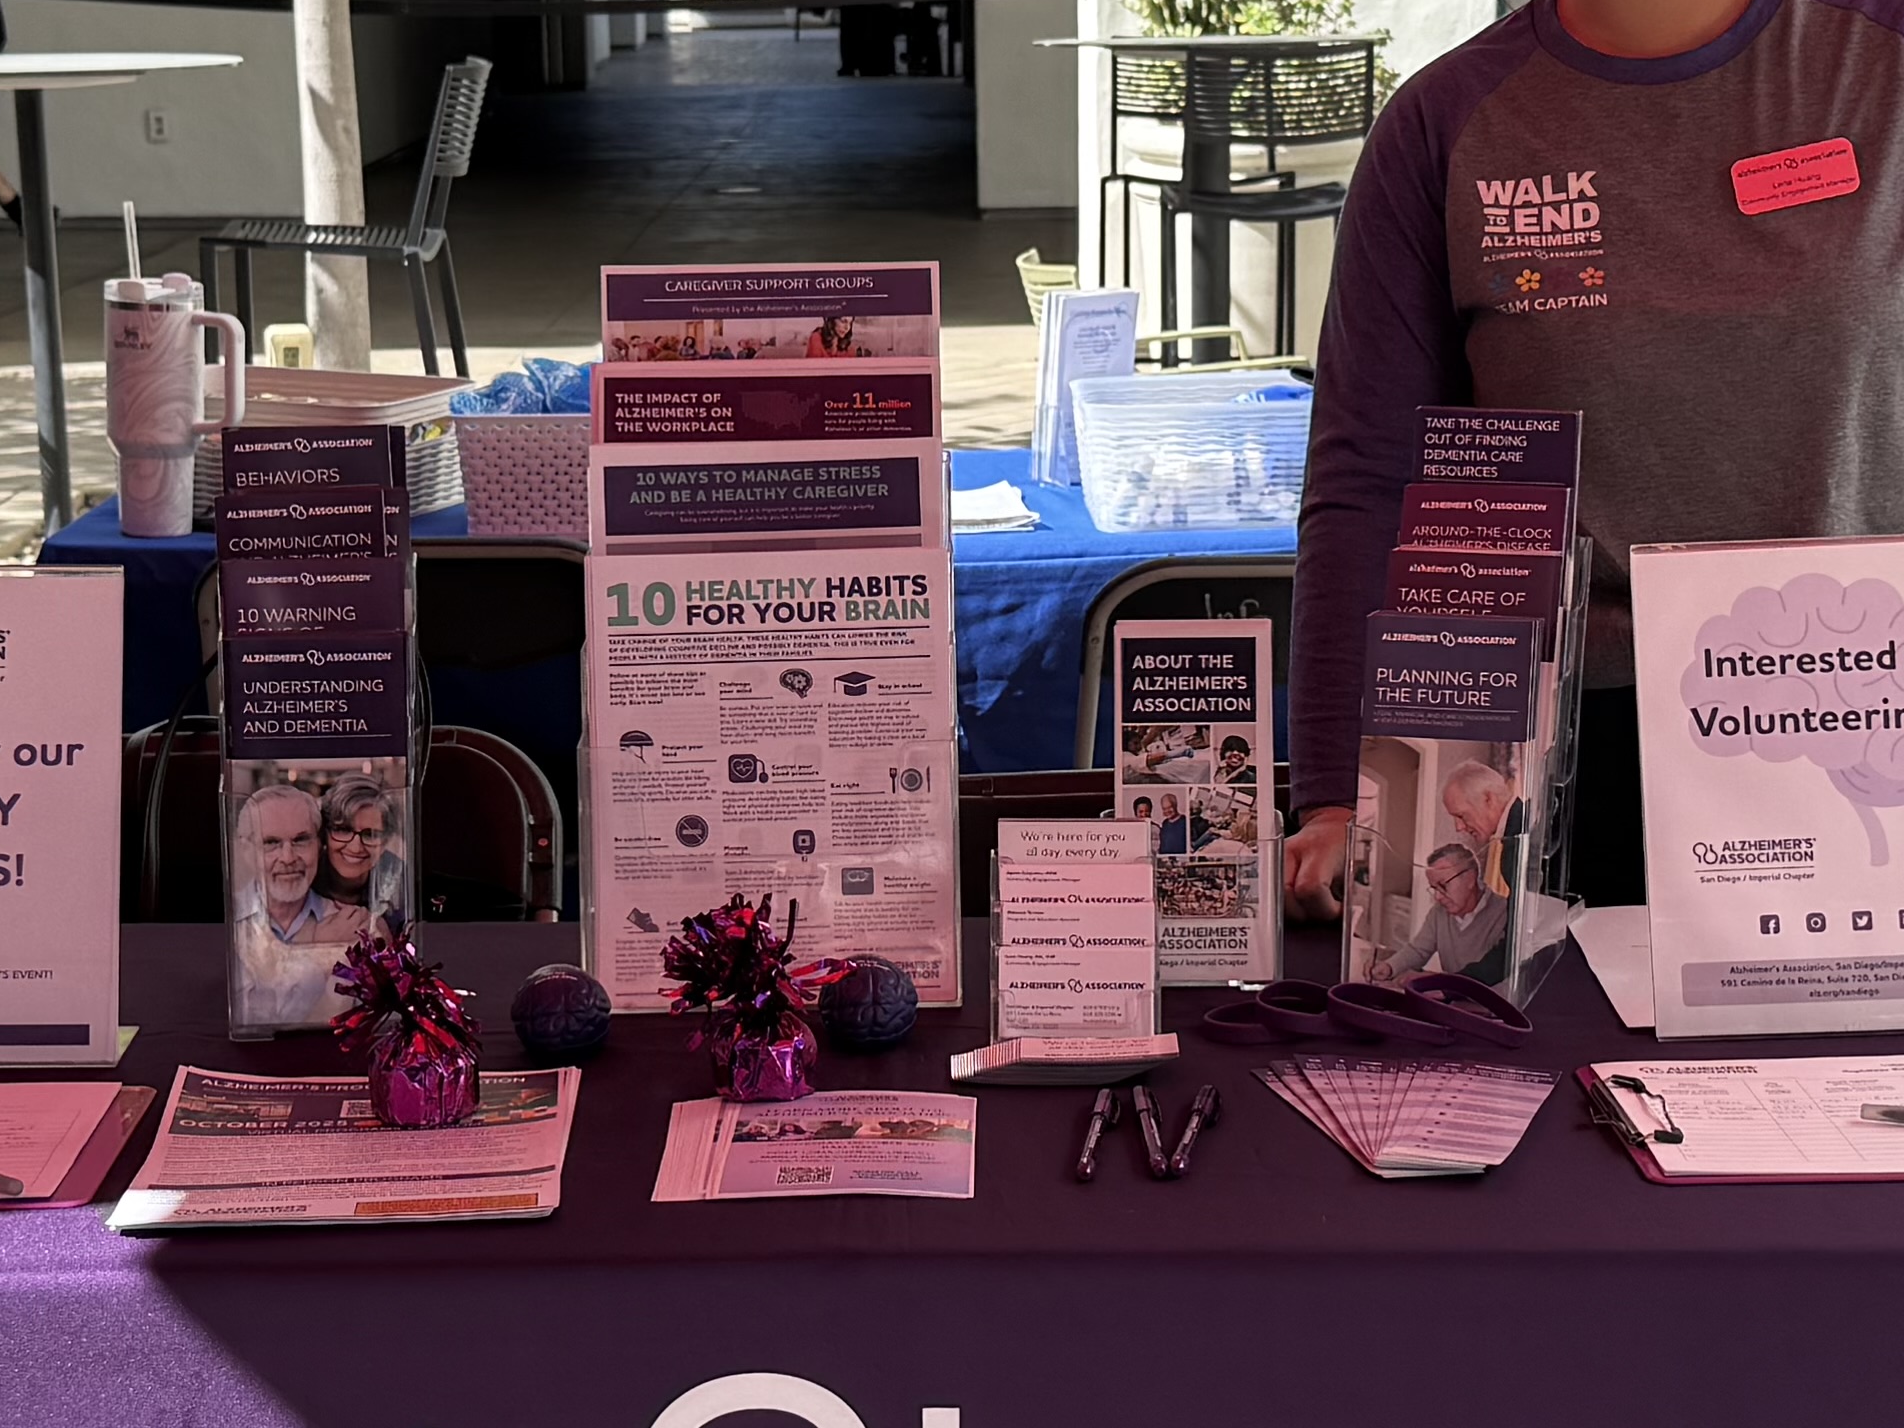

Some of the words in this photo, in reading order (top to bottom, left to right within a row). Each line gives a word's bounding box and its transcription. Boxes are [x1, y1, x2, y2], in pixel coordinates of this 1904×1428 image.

[1477, 171, 1597, 207] WALK
[1488, 215, 1506, 226] TO
[1514, 202, 1600, 233] END
[1481, 230, 1602, 248] ALZHEIMER'S
[666, 279, 741, 292] CAREGIVER
[747, 279, 809, 290] SUPPORT
[816, 277, 873, 289] GROUPS
[1534, 294, 1608, 311] CAPTAIN
[616, 394, 643, 403] THE
[647, 394, 697, 403] IMPACT
[703, 394, 721, 403] OF
[853, 393, 875, 408] 11
[879, 400, 911, 408] million
[616, 408, 706, 417] ALZHEIMER'S
[711, 407, 731, 417] ON
[616, 422, 643, 432] THE
[647, 422, 734, 432] WORKPLACE
[1426, 418, 1455, 428] TAKE
[1459, 419, 1482, 429] THE
[1486, 420, 1560, 431] CHALLENGE
[1425, 433, 1452, 444] OUT
[1455, 434, 1471, 444] OF
[1476, 435, 1527, 446] FINDING
[1425, 450, 1487, 460] DEMENTIA
[1491, 451, 1523, 462] CARE
[237, 469, 339, 486] BEHAVIORS
[637, 473, 655, 485] 10
[661, 472, 708, 484] WAYS
[713, 471, 736, 483] TO
[742, 469, 813, 482] MANAGE
[819, 466, 880, 480] STRESS
[1424, 465, 1497, 479] RESOURCES
[631, 491, 665, 503] AND
[671, 490, 690, 502] BE
[697, 490, 706, 501] A
[712, 488, 786, 501] HEALTHY
[793, 484, 888, 498] CAREGIVER
[309, 505, 371, 515] ASSOCIATION
[1413, 526, 1551, 540] AROUND-THE-CLOCK
[230, 534, 371, 552] COMMUNICATION
[686, 578, 816, 603] HEALTHY
[826, 575, 927, 599] HABITS
[1400, 588, 1441, 602] TAKE
[1447, 590, 1494, 605] CARE
[1501, 592, 1525, 605] OF
[607, 582, 675, 626] 10
[239, 609, 258, 623] 10
[264, 607, 355, 622] WARNING
[687, 604, 745, 625] FOR
[754, 602, 835, 623] YOUR
[846, 599, 929, 621] BRAIN
[1457, 636, 1516, 644] ASSOCIATION
[1133, 655, 1192, 668] ABOUT
[1199, 655, 1233, 668] THE
[1705, 641, 1895, 676] Interested
[1133, 676, 1247, 690] ALZHEIMER'S
[1377, 669, 1472, 685] PLANNING
[1480, 672, 1517, 686] FOR
[244, 680, 383, 694] UNDERSTANDING
[1133, 698, 1250, 711] ASSOCIATION
[1376, 688, 1410, 702] THE
[1418, 689, 1490, 707] FUTURE
[244, 700, 347, 713] ALZHEIMER'S
[244, 720, 279, 733] AND
[284, 719, 367, 735] DEMENTIA
[14, 743, 83, 766] our
[1021, 832, 1053, 842] We're
[1057, 832, 1082, 842] here
[1086, 832, 1102, 842] for
[1106, 834, 1125, 843] you
[1723, 839, 1815, 853] ALZHEIMER'S
[1066, 849, 1096, 858] every
[1717, 850, 1813, 864] ASSOCIATION
[1717, 876, 1740, 884] Diego
[1162, 927, 1248, 939] ALZHEIMER'S
[1158, 937, 1247, 949] ASSOCIATION
[202, 1078, 320, 1092] ALZHEIMER'S
[179, 1119, 286, 1131] OCTOBER
